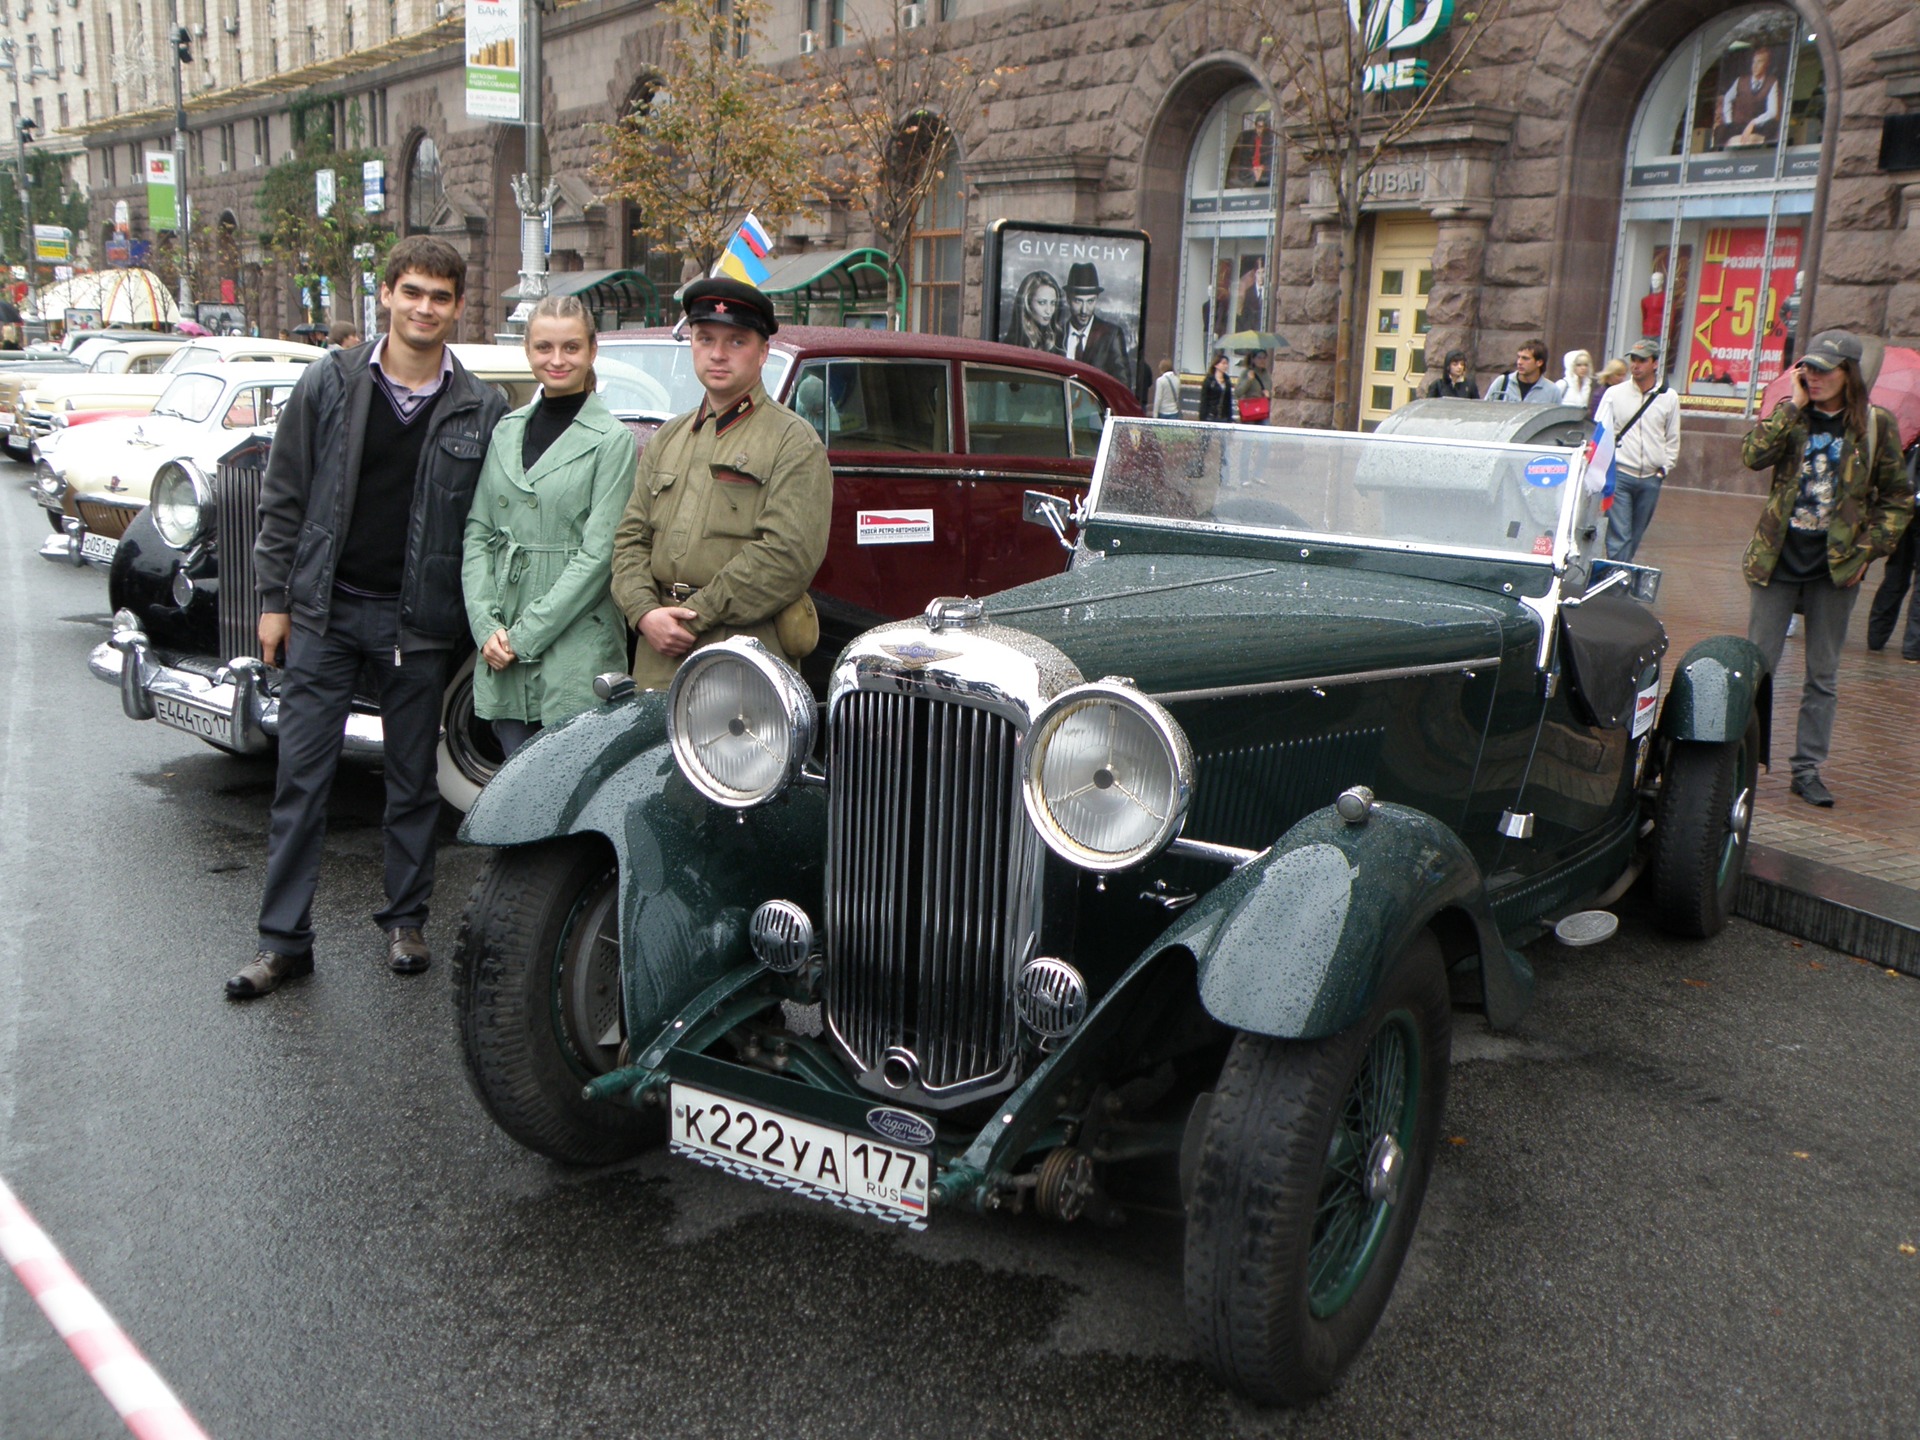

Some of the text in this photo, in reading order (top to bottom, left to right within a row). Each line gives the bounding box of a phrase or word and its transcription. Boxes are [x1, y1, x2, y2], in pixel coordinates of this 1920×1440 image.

[477, 5, 509, 17] БАНК
[1019, 239, 1130, 262] GIVENCHY
[897, 647, 934, 656] LAGONDA
[877, 1110, 928, 1137] Lagonda
[852, 1143, 917, 1189] 177
[866, 1181, 899, 1202] RUS
